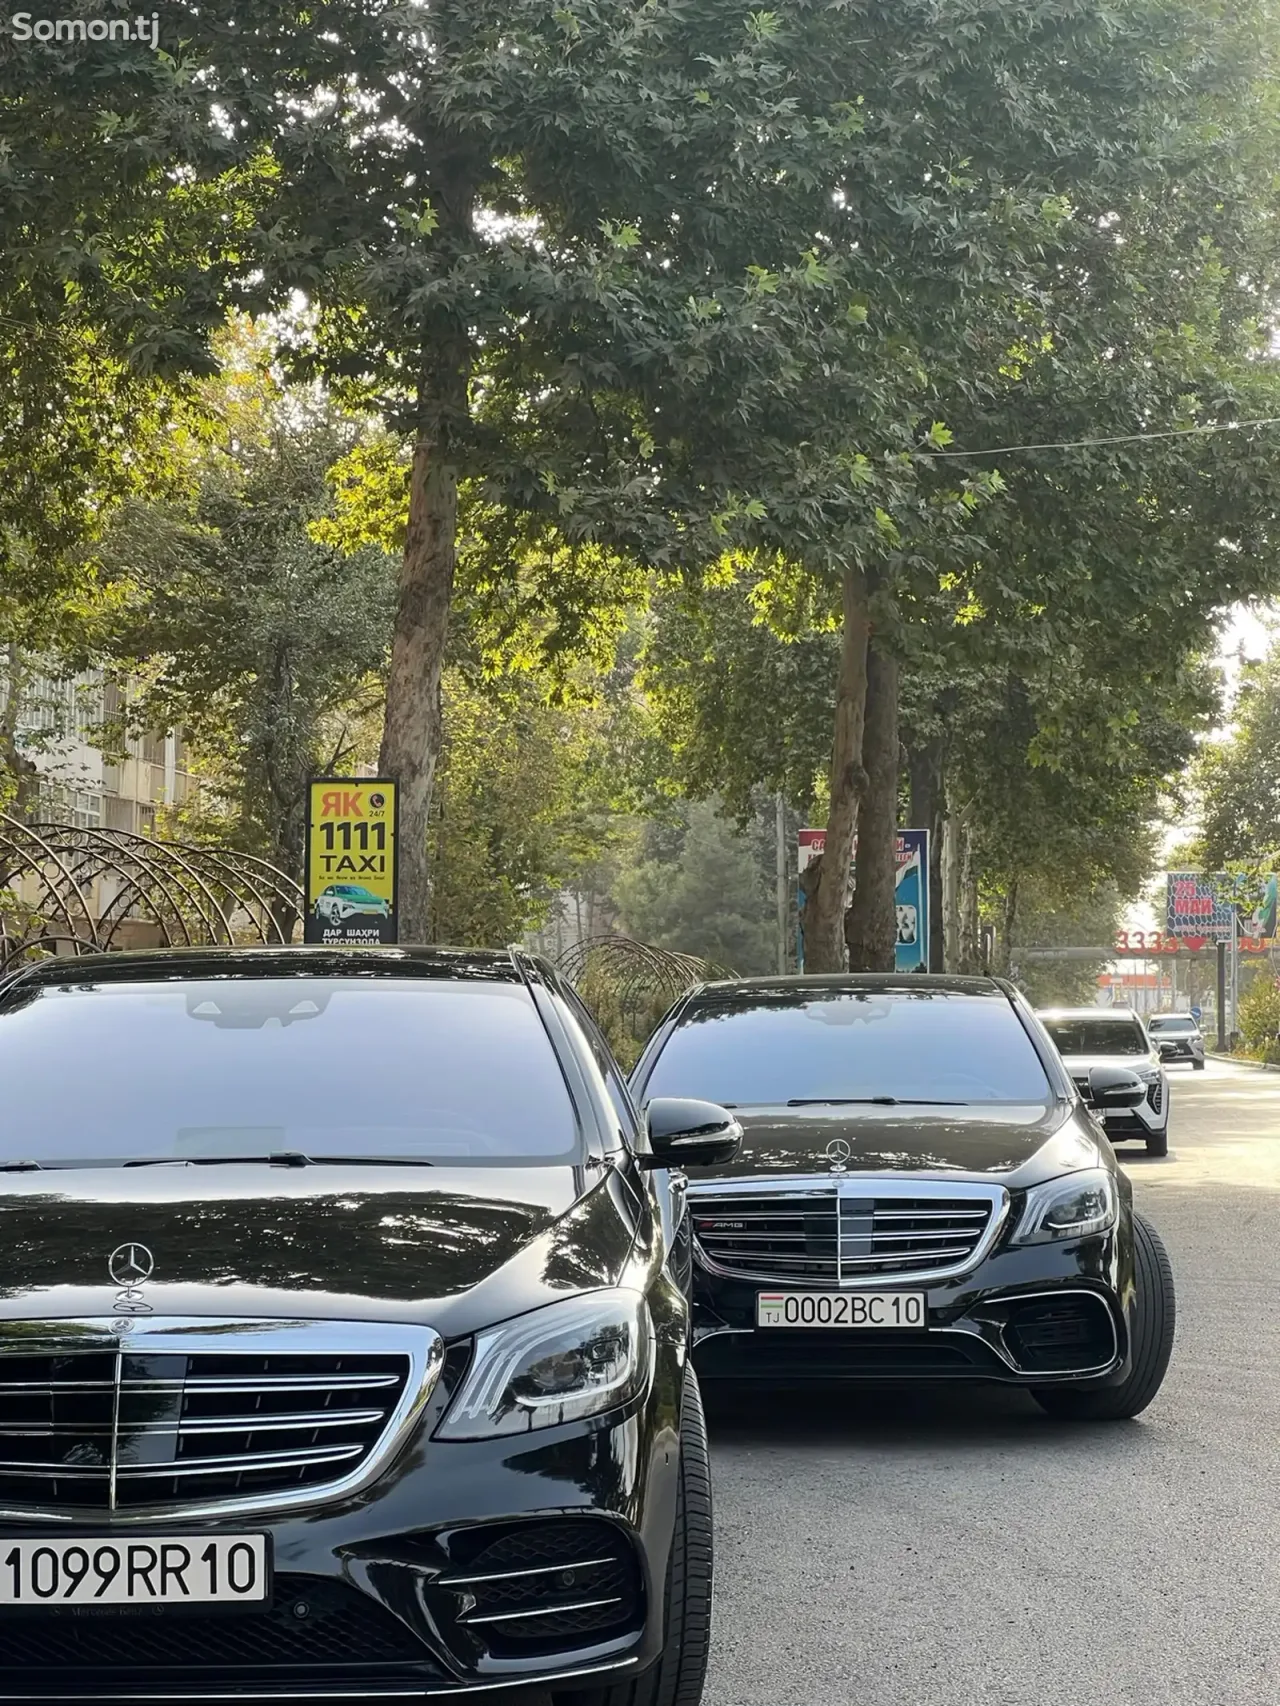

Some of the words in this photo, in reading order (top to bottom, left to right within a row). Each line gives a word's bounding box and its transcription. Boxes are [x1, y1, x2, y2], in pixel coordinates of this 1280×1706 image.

[320, 791, 364, 817] ЯК
[368, 810, 385, 818] 24/7
[319, 821, 386, 850] 1111
[319, 855, 385, 872] TAXI
[1174, 880, 1197, 897] 25
[323, 928, 342, 938] ДАР
[765, 1312, 781, 1324] TJ
